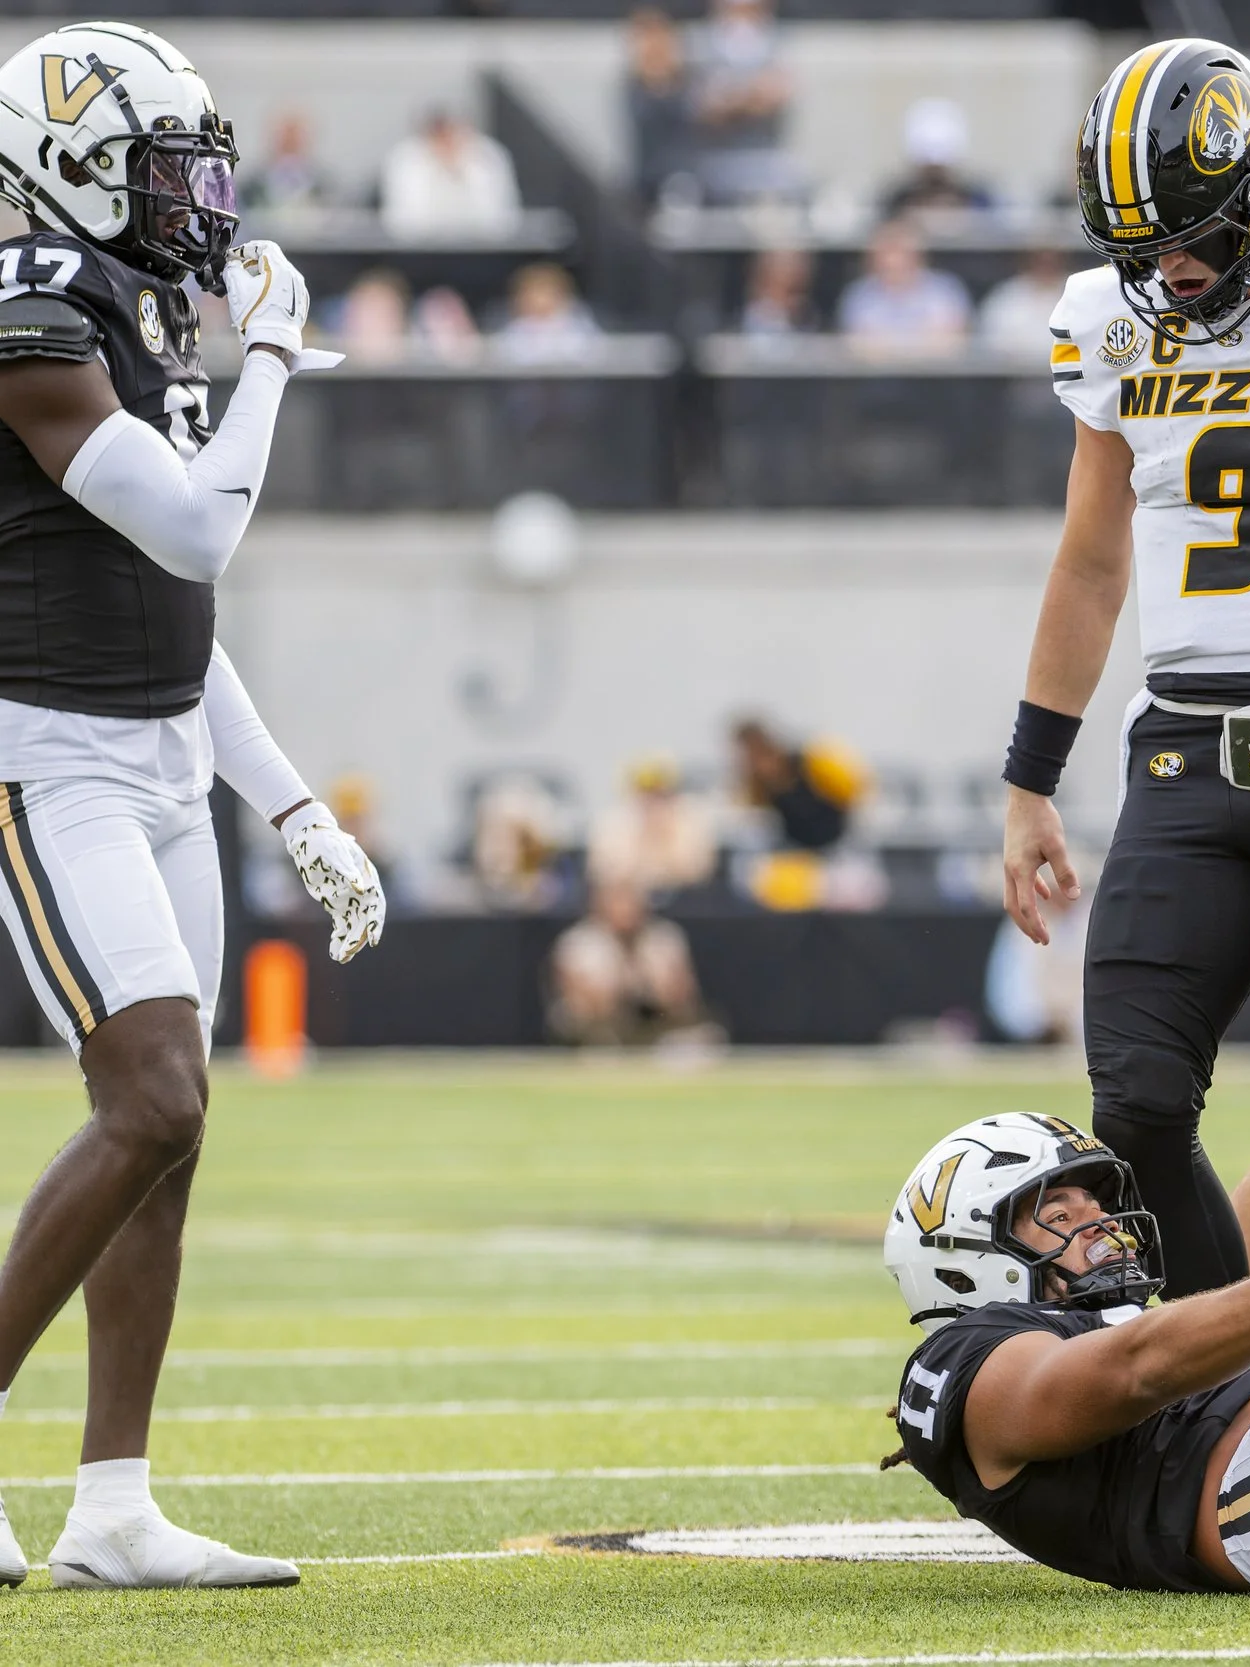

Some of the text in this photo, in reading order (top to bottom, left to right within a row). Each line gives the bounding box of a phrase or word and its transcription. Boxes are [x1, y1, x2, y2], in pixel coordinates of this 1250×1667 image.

[1112, 225, 1154, 239] MIZZOU
[1106, 320, 1136, 351] SEC
[1150, 313, 1190, 368] C
[1103, 346, 1140, 369] GRADUATE
[906, 1149, 970, 1235] V
